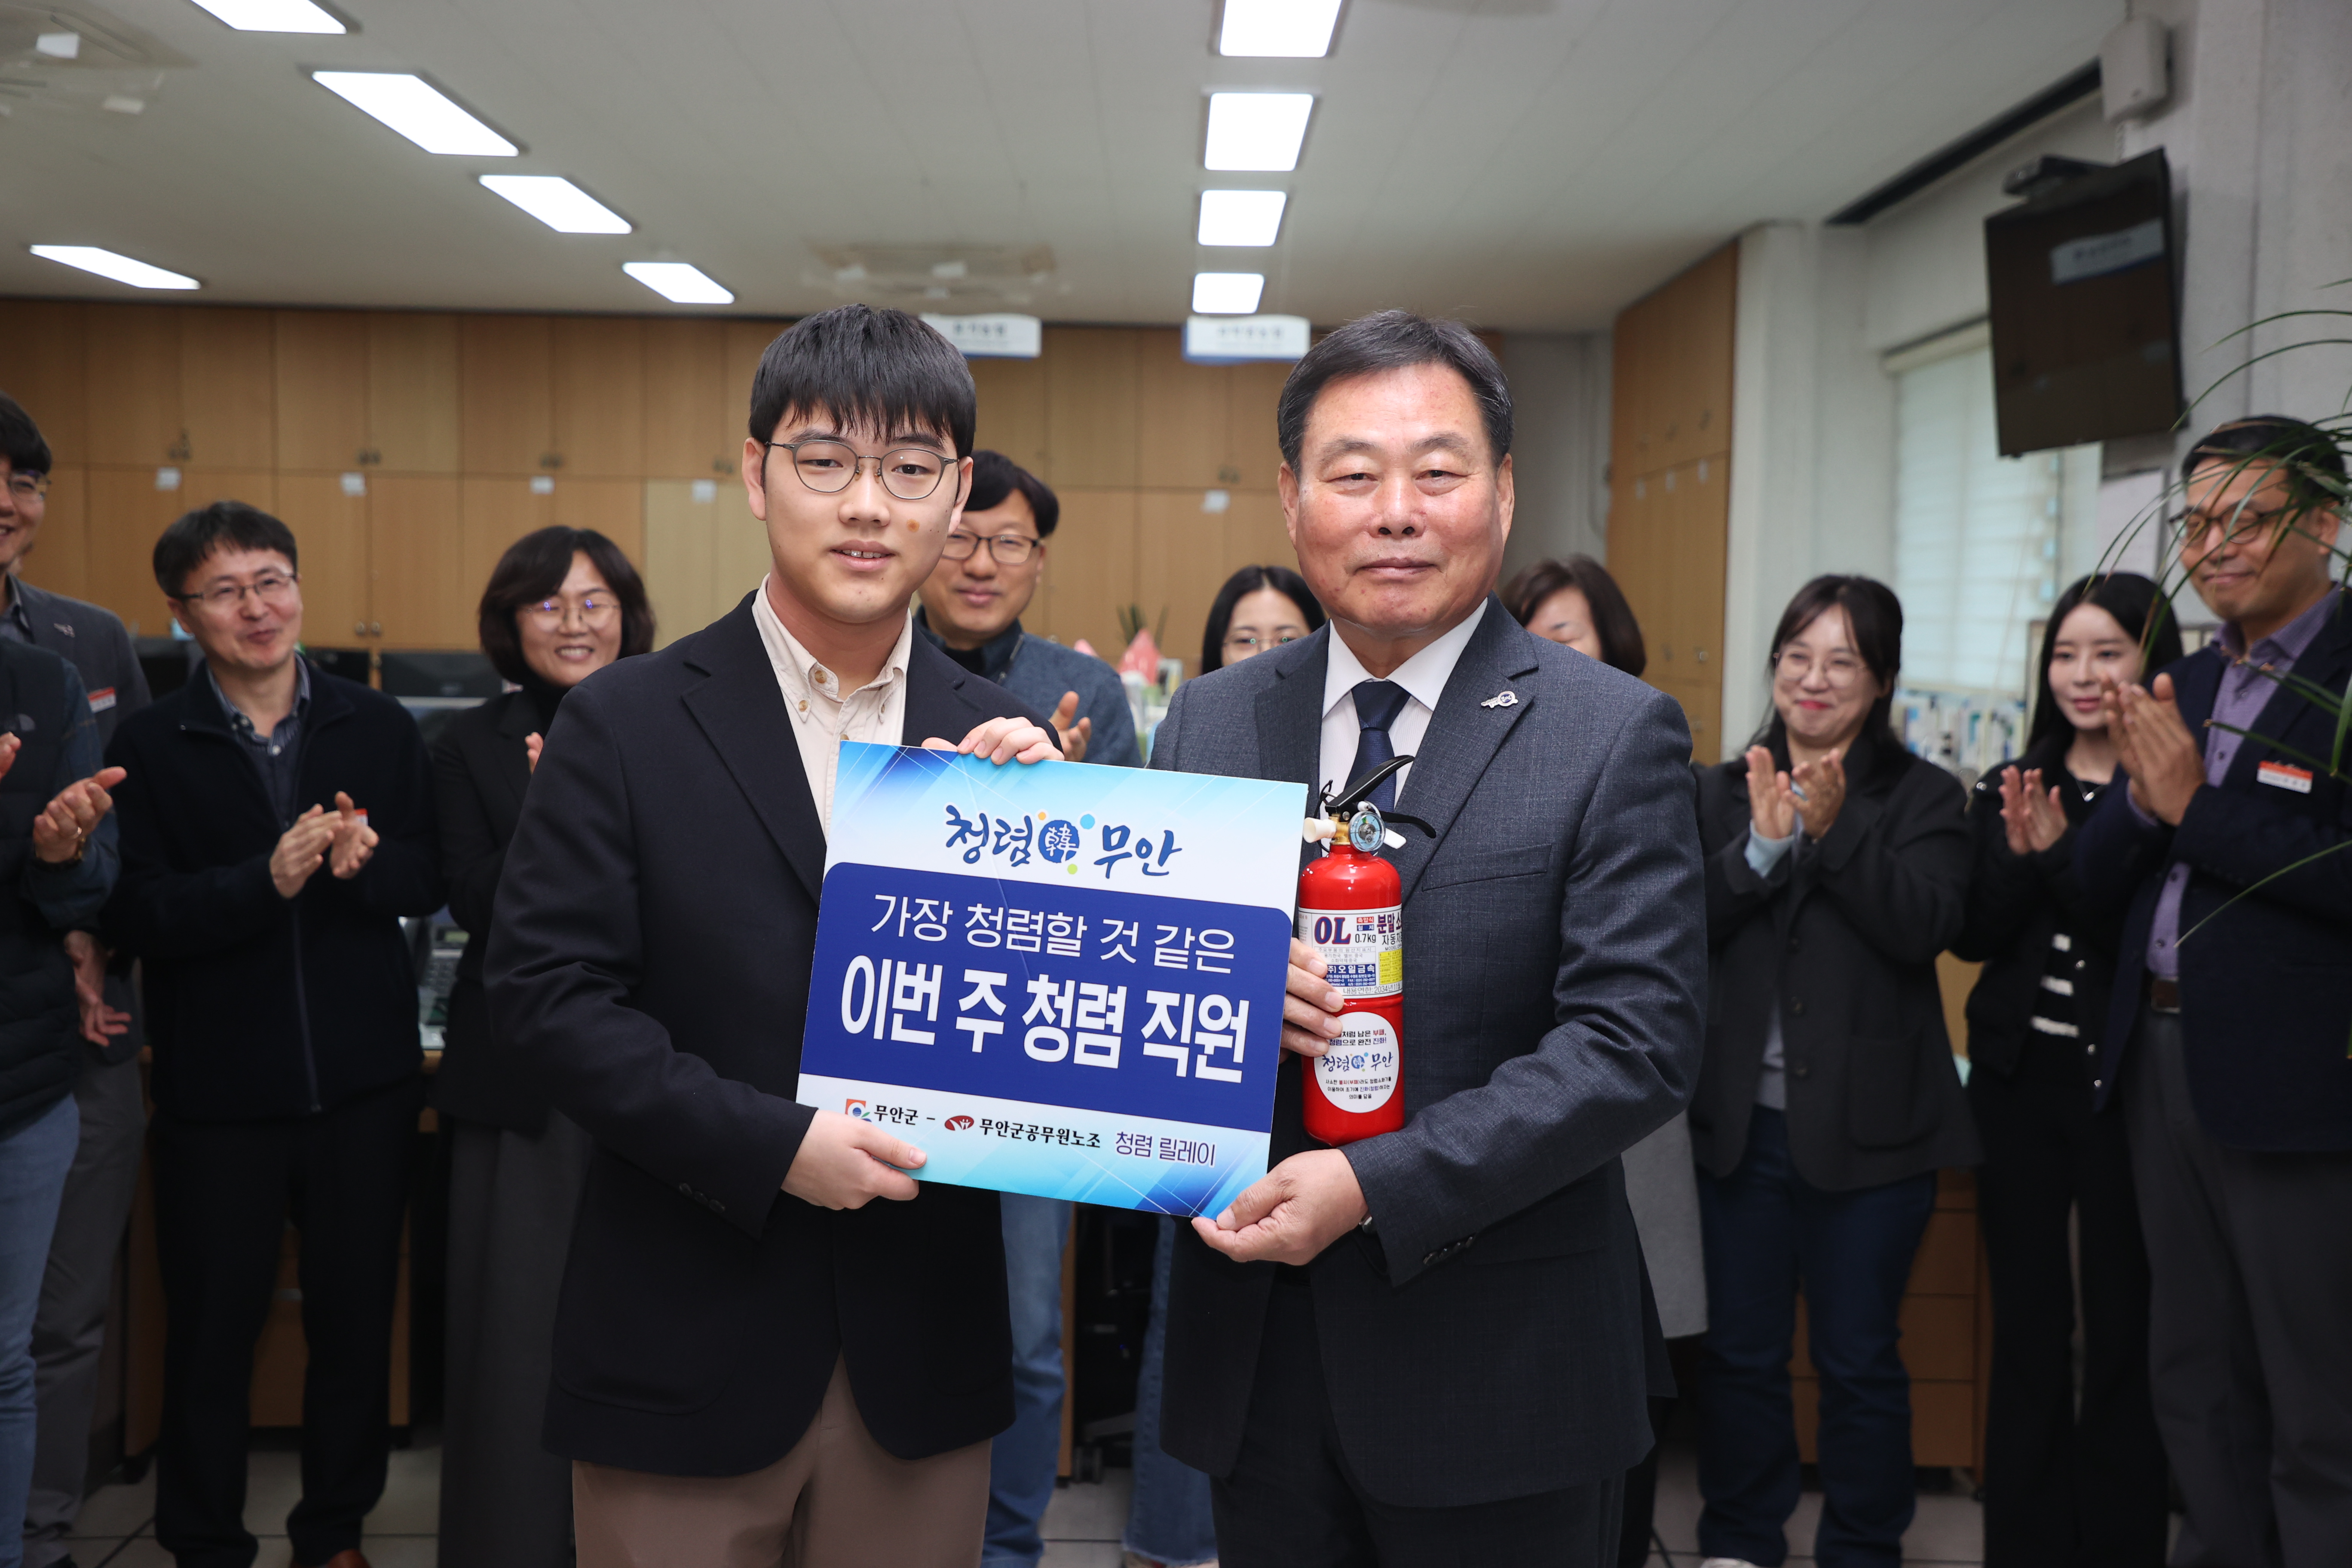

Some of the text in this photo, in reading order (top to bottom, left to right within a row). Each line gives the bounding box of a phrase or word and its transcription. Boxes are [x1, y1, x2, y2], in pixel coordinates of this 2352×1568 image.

[946, 805, 1033, 867] 청렴
[1093, 825, 1182, 879] 무안
[872, 894, 1235, 974] 가장 청렴할 것 같은
[1355, 933, 1376, 943] 0.7kg
[1377, 913, 1395, 934] 분말
[1328, 965, 1375, 974] 주)오일금속
[841, 955, 1250, 1084] 이번 주 청렴 직원
[1322, 1055, 1350, 1072] 청렴
[1370, 1052, 1393, 1071] 무안
[874, 1105, 919, 1126] 무안군
[980, 1118, 1101, 1148] 무안군공무원노조
[1116, 1131, 1153, 1158] 청렴
[1159, 1137, 1216, 1166] 릴레이
